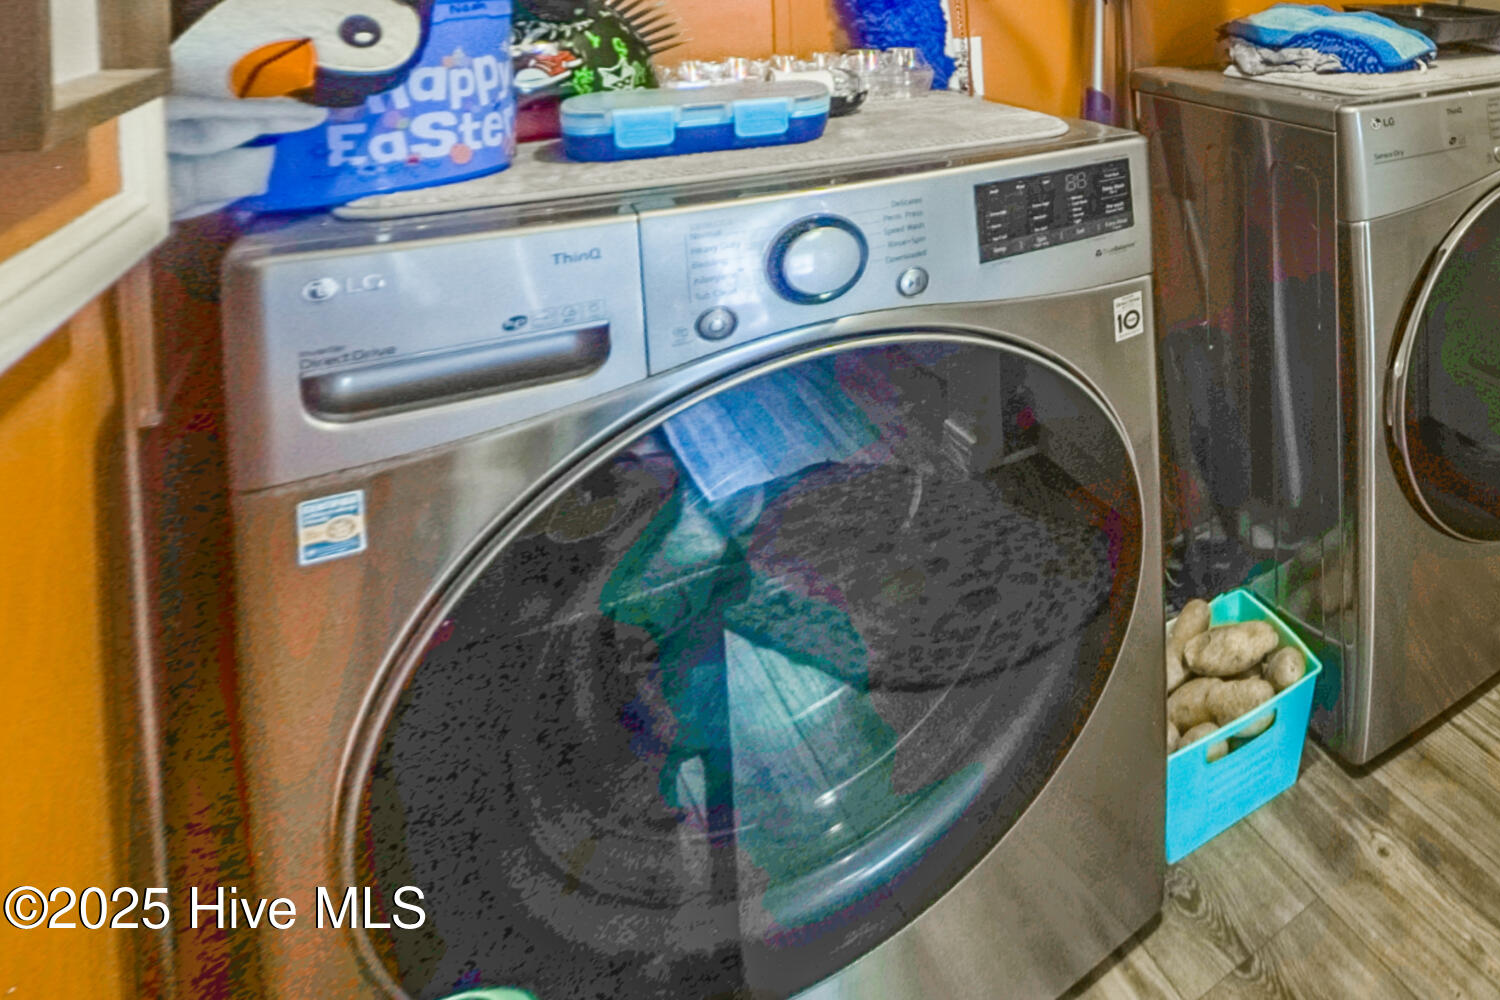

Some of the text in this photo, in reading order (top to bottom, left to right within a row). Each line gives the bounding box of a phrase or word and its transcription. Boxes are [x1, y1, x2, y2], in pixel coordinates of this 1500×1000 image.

[552, 247, 602, 265] ThinQ
[346, 273, 387, 293] LG
[1117, 309, 1141, 334] 10
